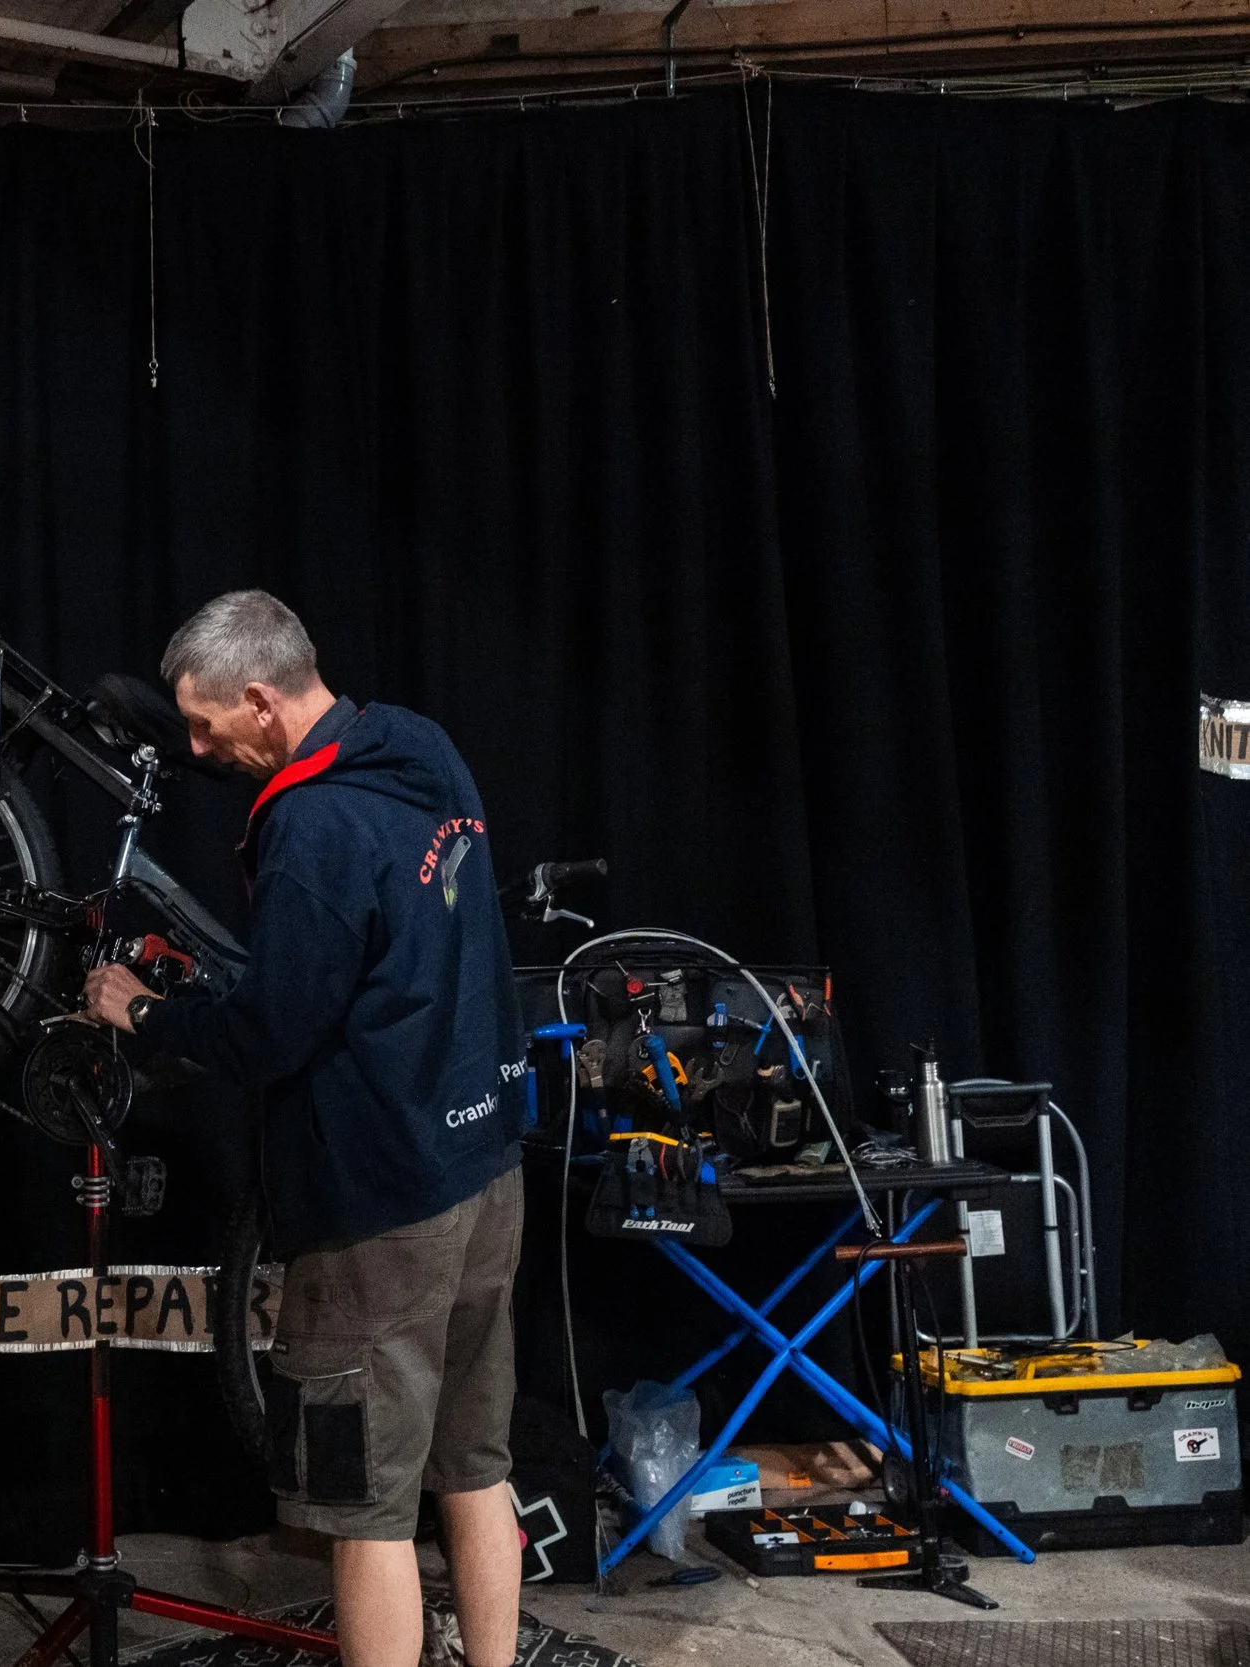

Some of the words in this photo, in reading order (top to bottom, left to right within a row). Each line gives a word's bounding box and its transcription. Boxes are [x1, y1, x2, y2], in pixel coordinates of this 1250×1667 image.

[446, 1093, 499, 1128] Crank
[727, 1487, 756, 1501] puncture
[728, 1496, 748, 1506] repair
